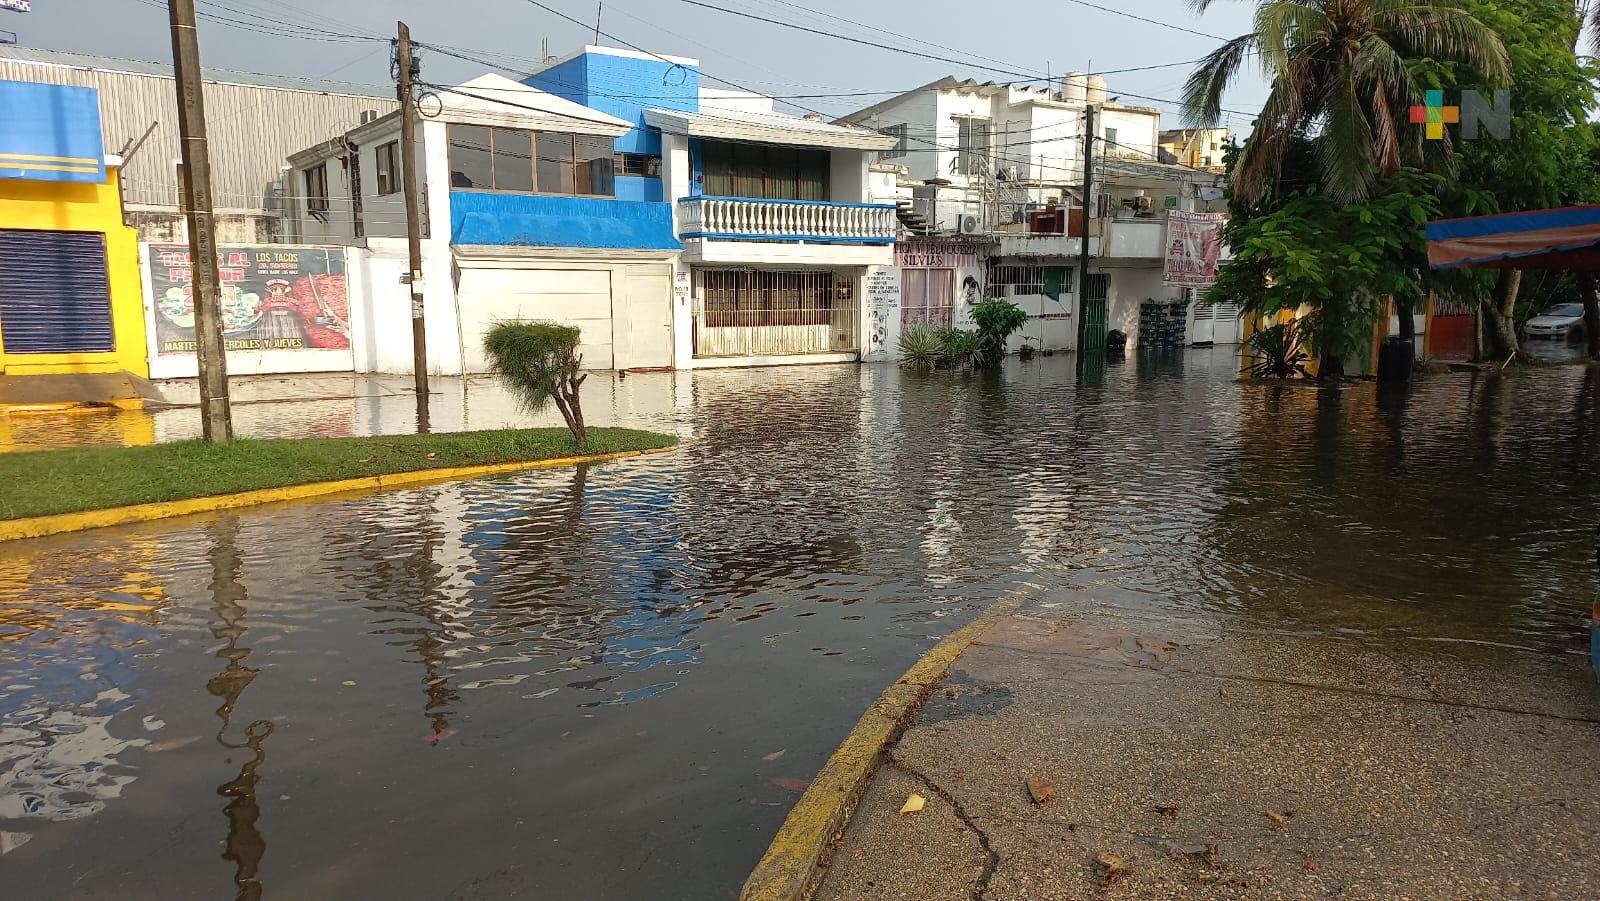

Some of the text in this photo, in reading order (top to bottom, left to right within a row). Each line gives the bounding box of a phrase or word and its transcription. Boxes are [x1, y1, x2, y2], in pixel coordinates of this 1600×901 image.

[228, 252, 252, 267] AL
[255, 252, 299, 263] LOS TACOS
[168, 266, 245, 282] PAOR
[223, 340, 260, 350] ERCOLES
[264, 339, 270, 349] Y
[273, 338, 303, 348] JUEVES
